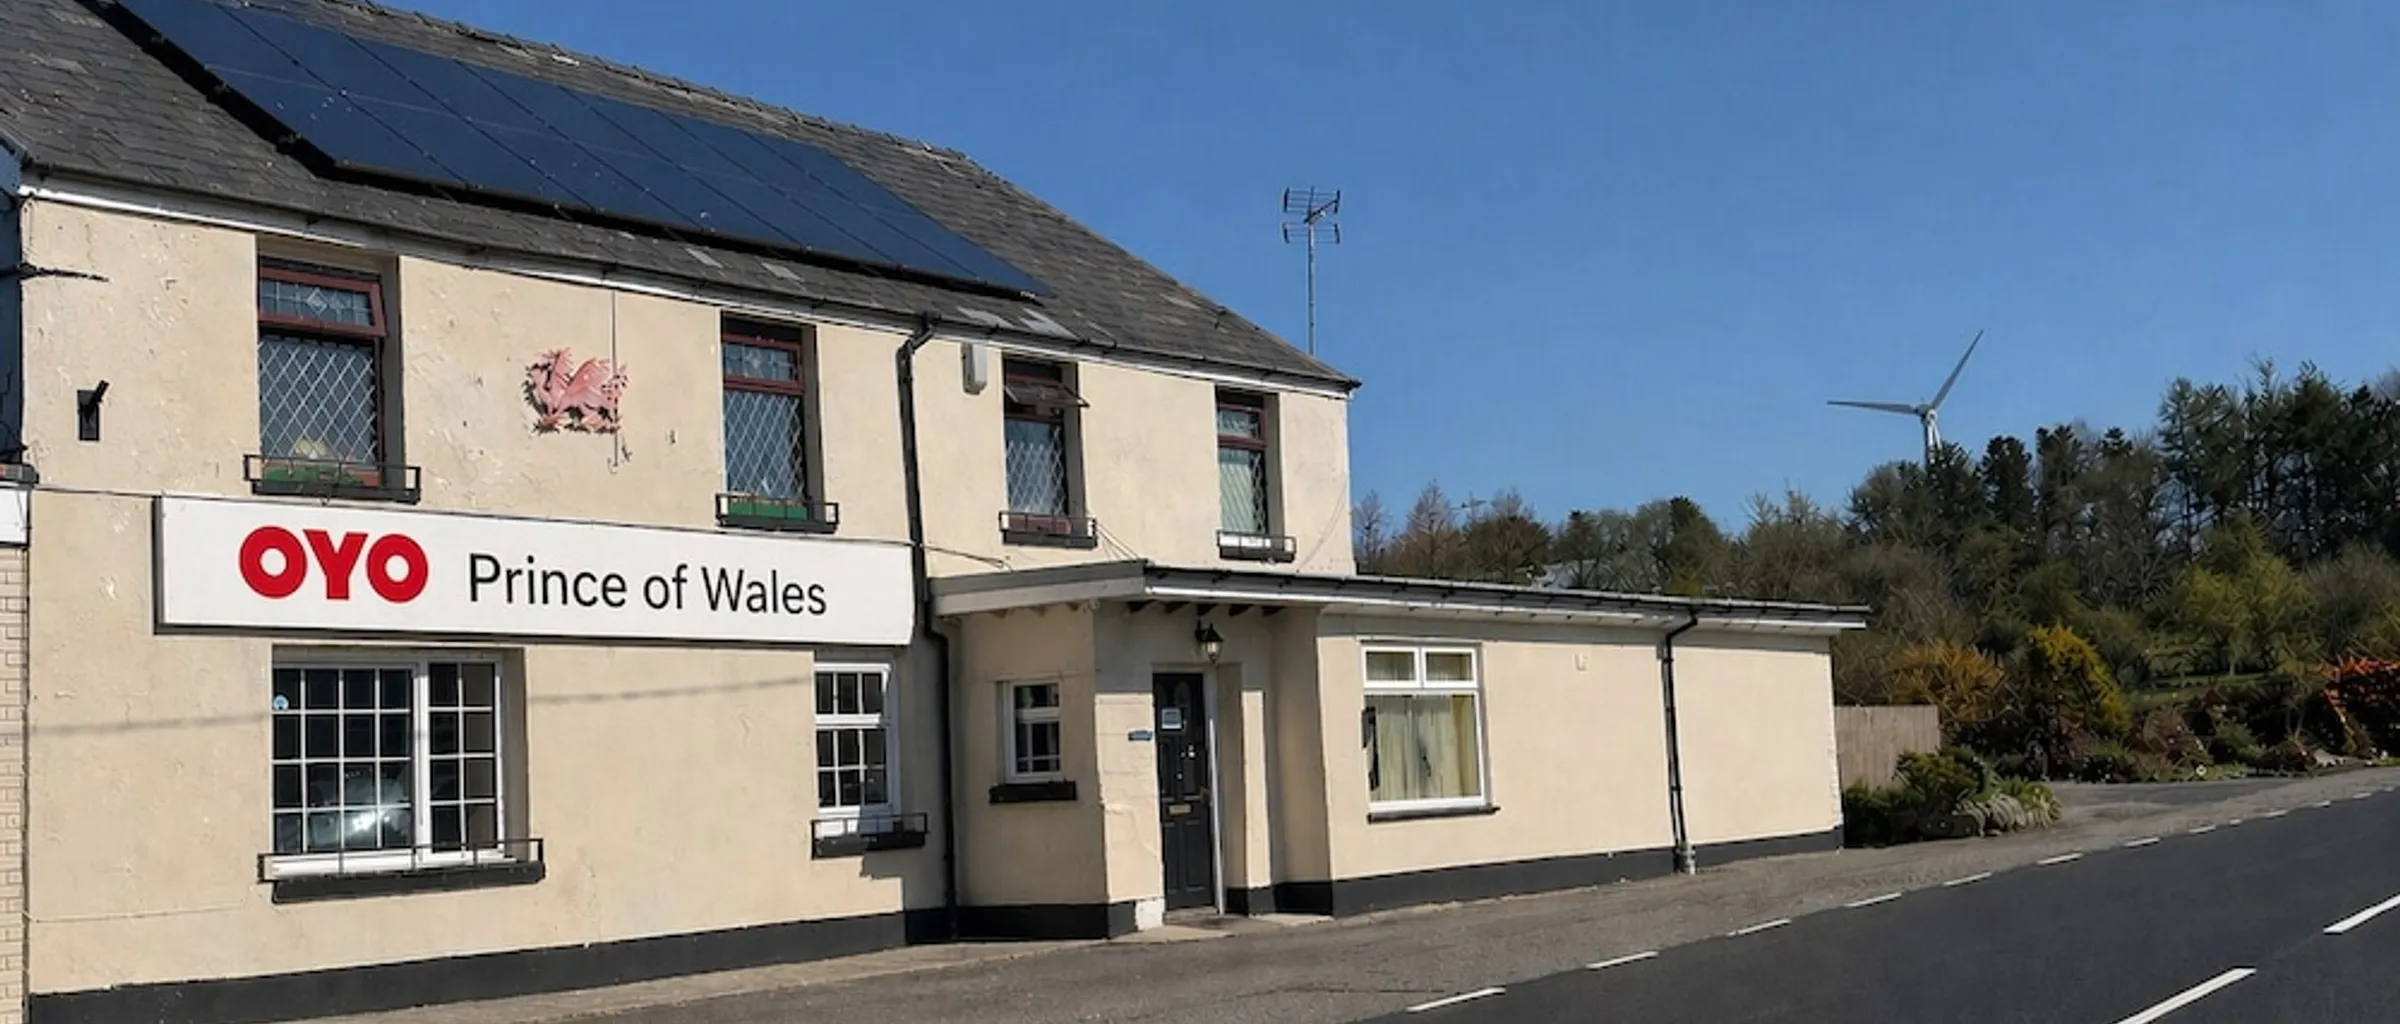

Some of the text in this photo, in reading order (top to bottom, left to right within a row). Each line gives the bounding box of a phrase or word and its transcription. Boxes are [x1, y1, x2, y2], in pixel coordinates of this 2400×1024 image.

[239, 526, 827, 616] OYO Prince of Wales
